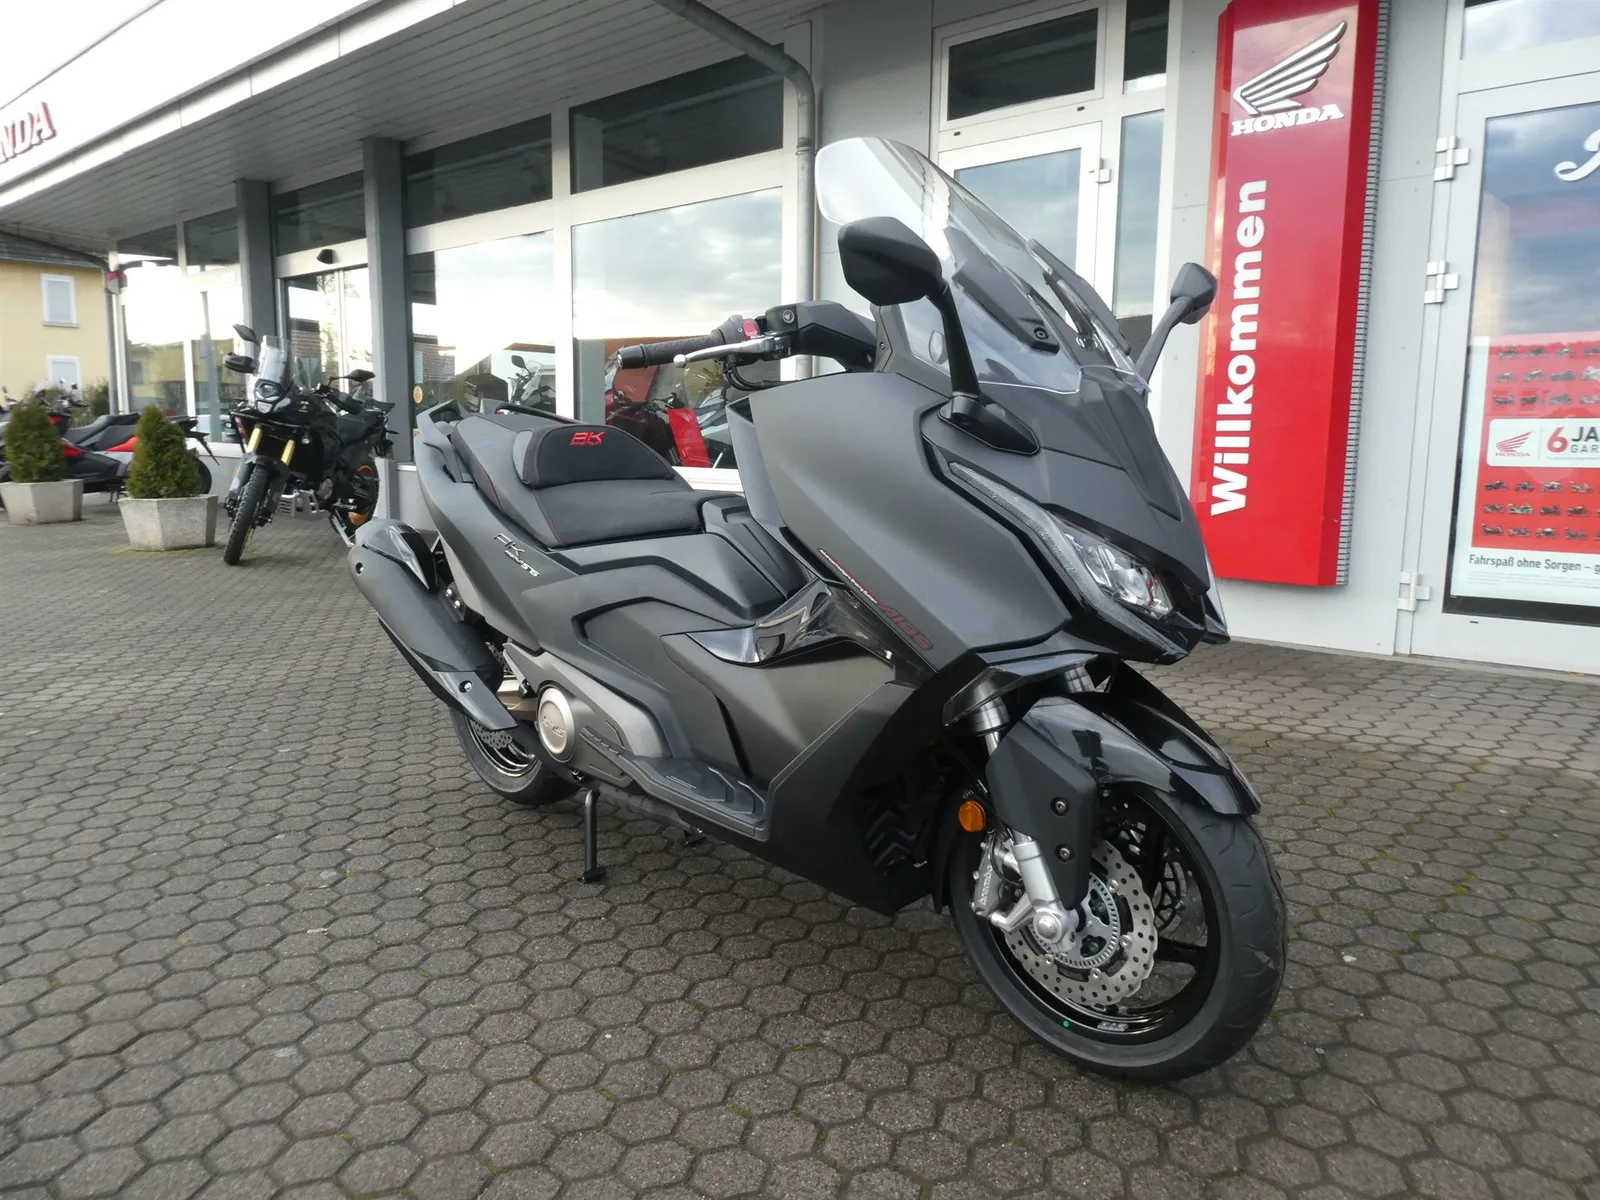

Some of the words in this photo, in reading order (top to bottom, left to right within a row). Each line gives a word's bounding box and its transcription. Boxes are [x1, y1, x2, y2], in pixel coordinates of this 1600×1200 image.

[1231, 104, 1345, 136] HONDA
[1210, 179, 1267, 516] Willkommen
[1547, 426, 1568, 453] 6
[1469, 554, 1514, 568] Fahrspaß
[1516, 557, 1542, 569] ohne
[1544, 558, 1582, 573] Sorgen
[980, 865, 993, 906] brembo
